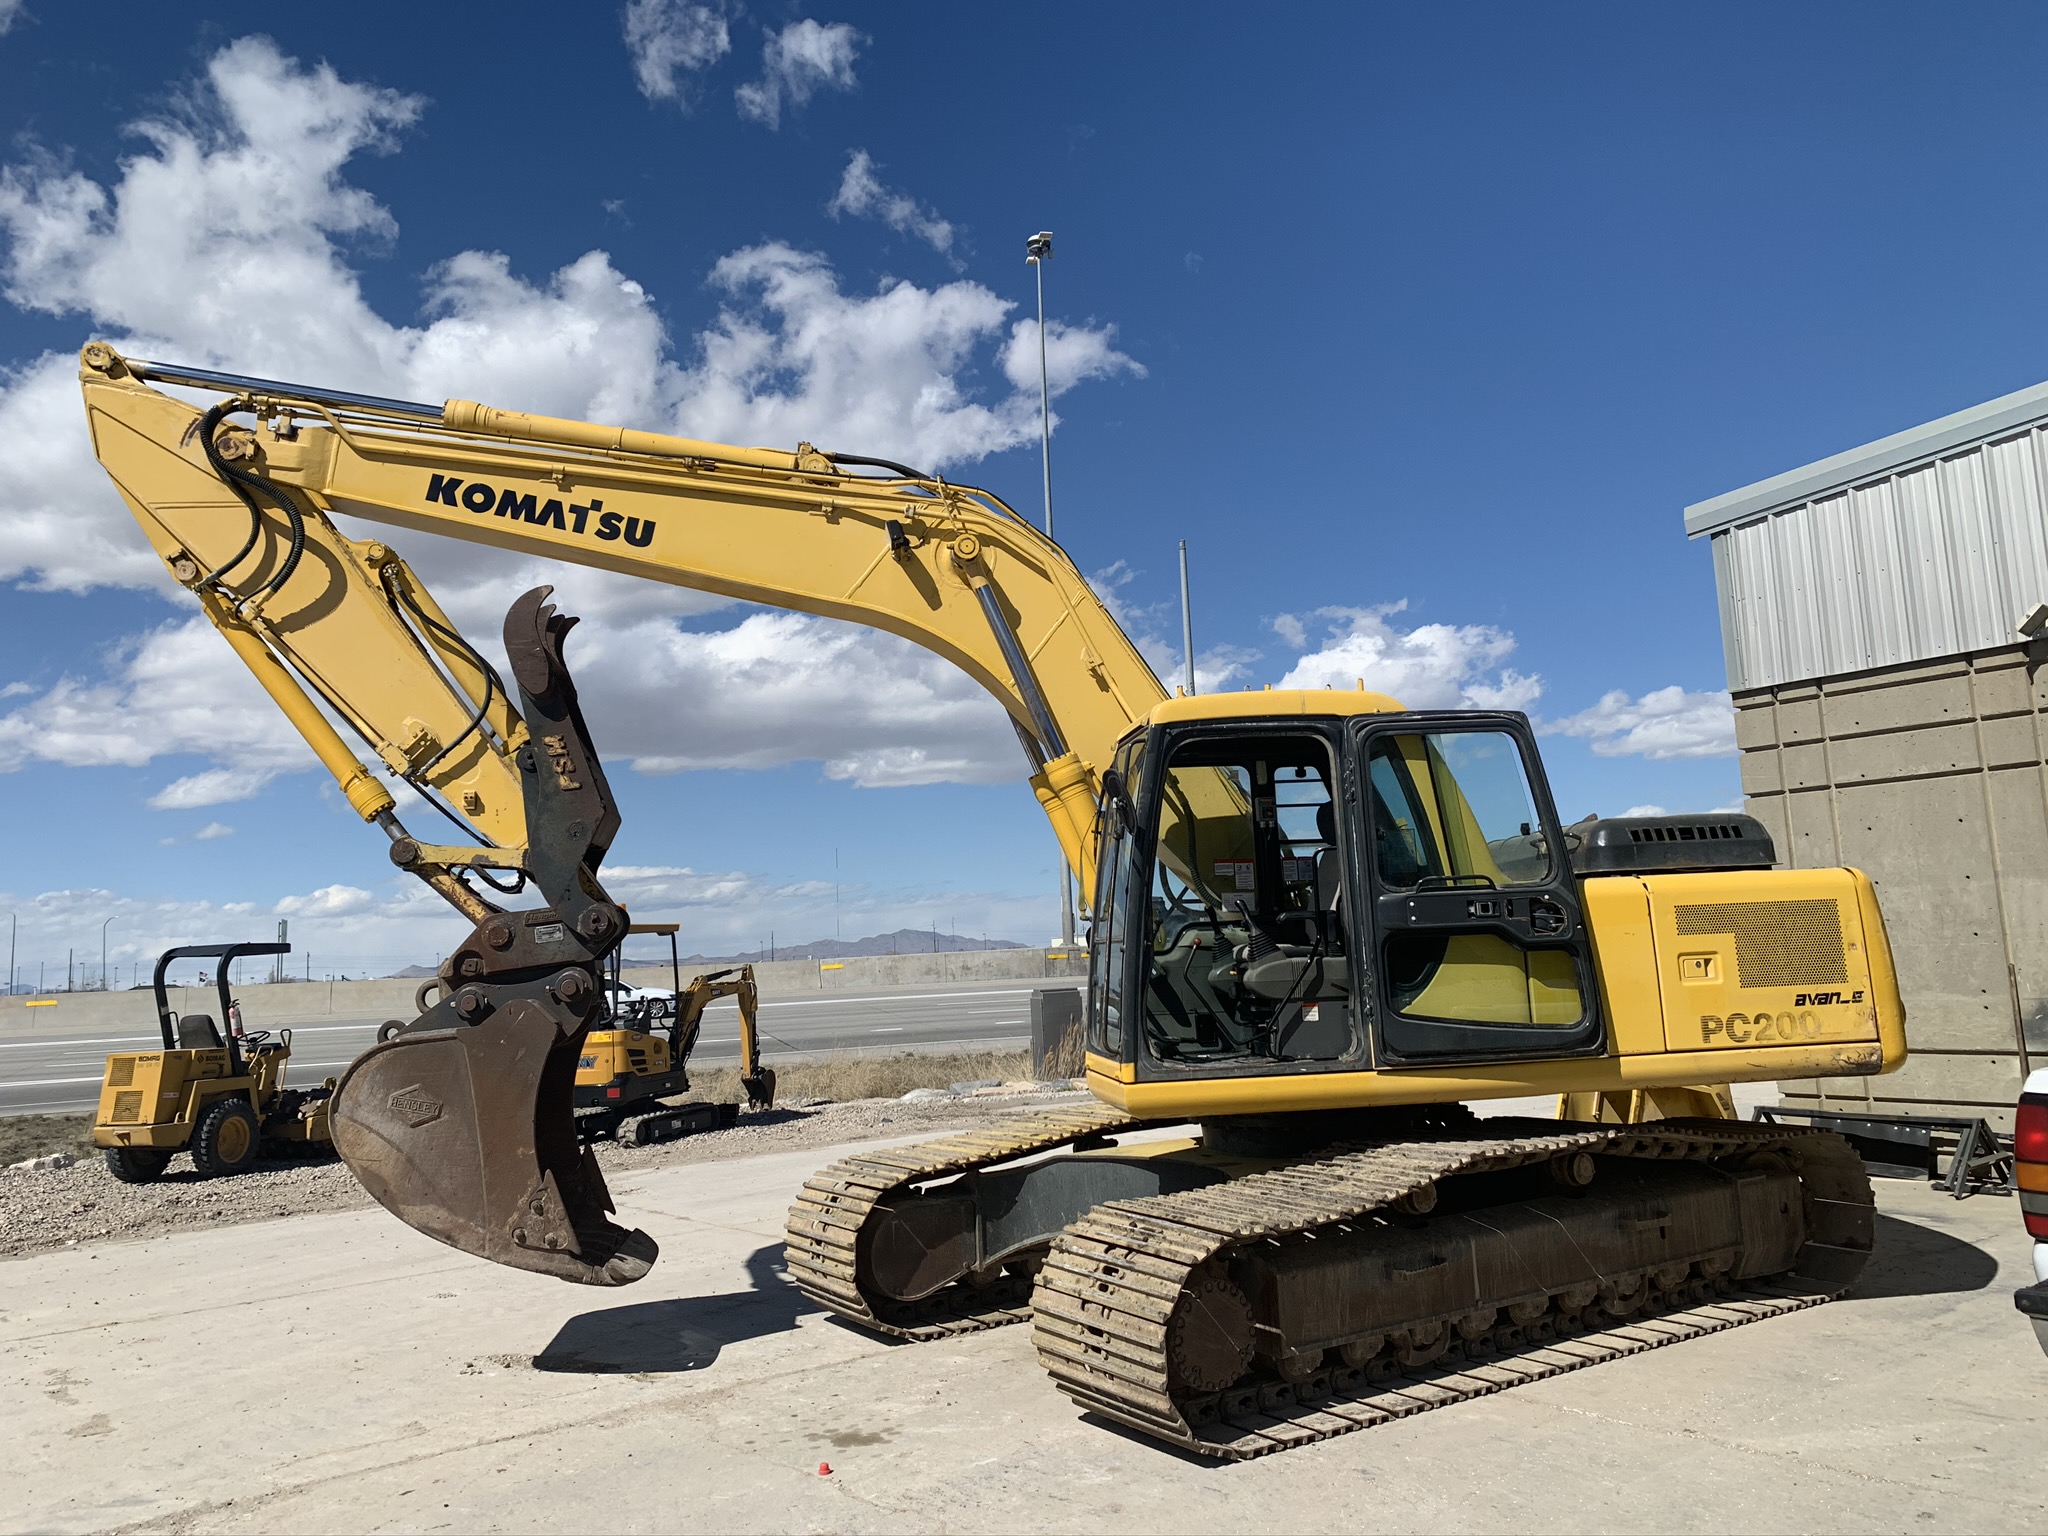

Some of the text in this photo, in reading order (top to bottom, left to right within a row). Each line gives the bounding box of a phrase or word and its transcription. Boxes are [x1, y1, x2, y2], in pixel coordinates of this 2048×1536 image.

[425, 473, 657, 548] KOMATSU
[1795, 990, 1865, 1007] avane
[1700, 1010, 1822, 1044] PC200
[577, 1056, 599, 1069] NY
[391, 1097, 439, 1114] HENSLEY
